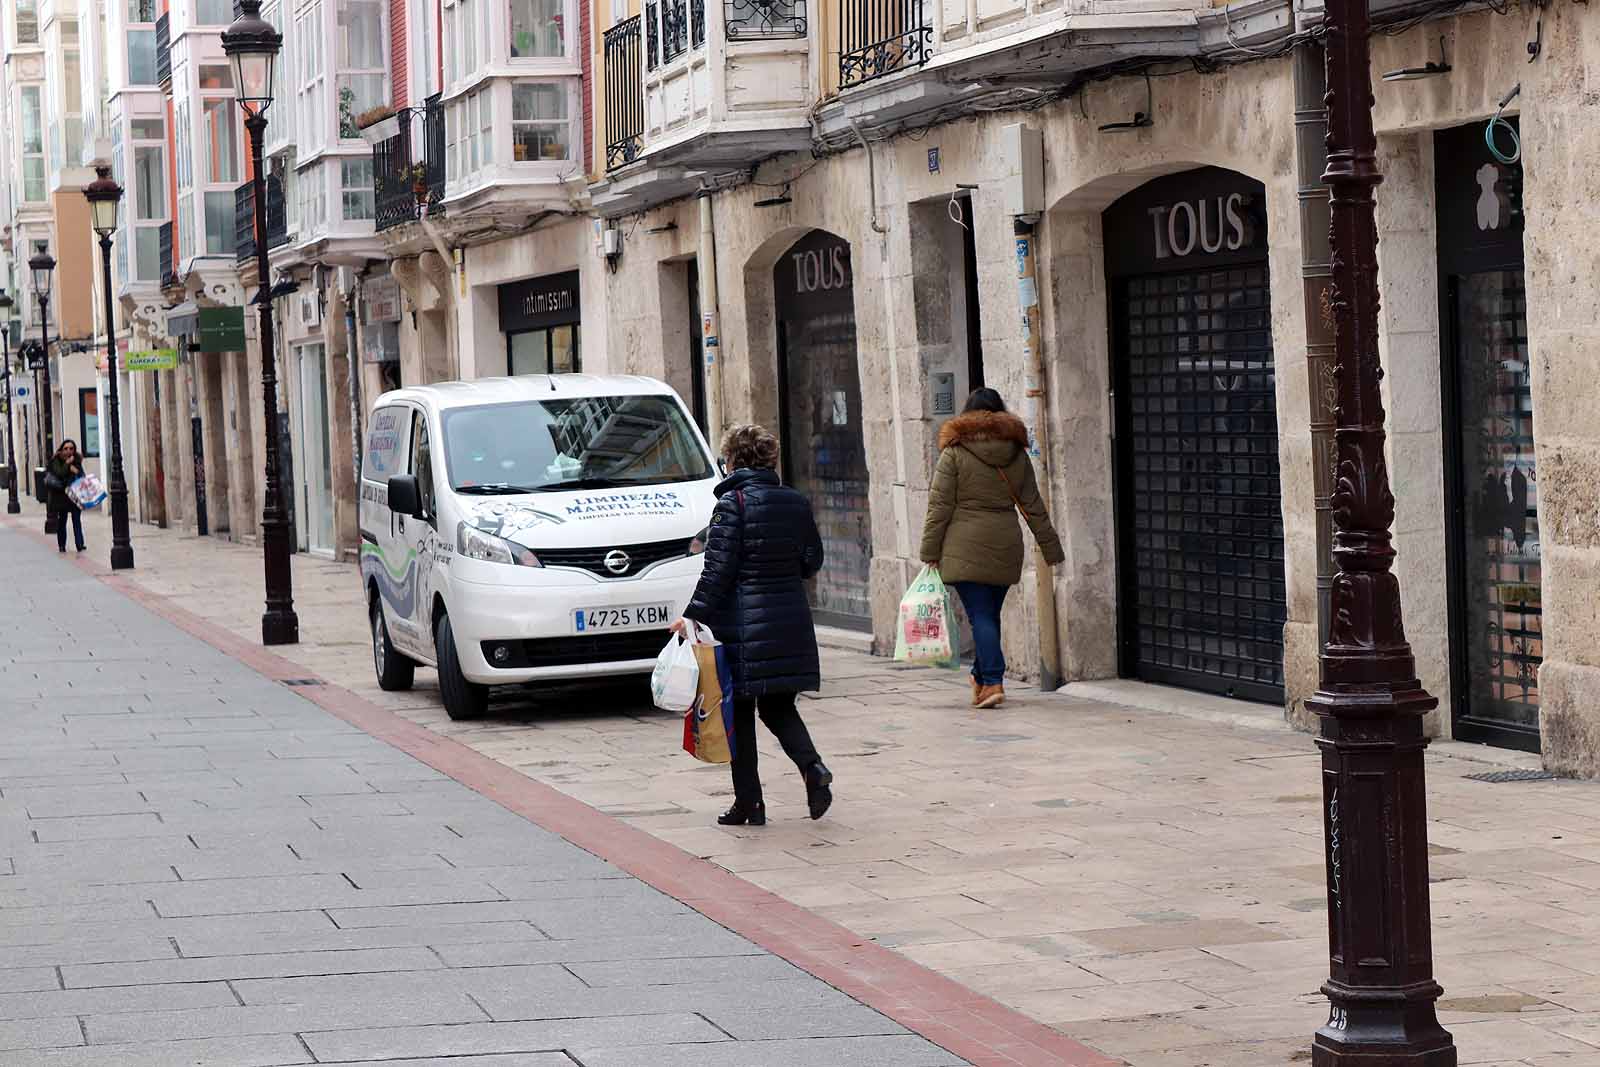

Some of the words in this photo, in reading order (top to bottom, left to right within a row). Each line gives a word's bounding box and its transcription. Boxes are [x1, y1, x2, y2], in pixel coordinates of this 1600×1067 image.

[1147, 192, 1244, 259] TOUS
[792, 246, 844, 293] TOUS
[575, 491, 678, 505] LIMPIEZAS
[588, 609, 631, 627] 4725
[636, 606, 669, 625] KBM
